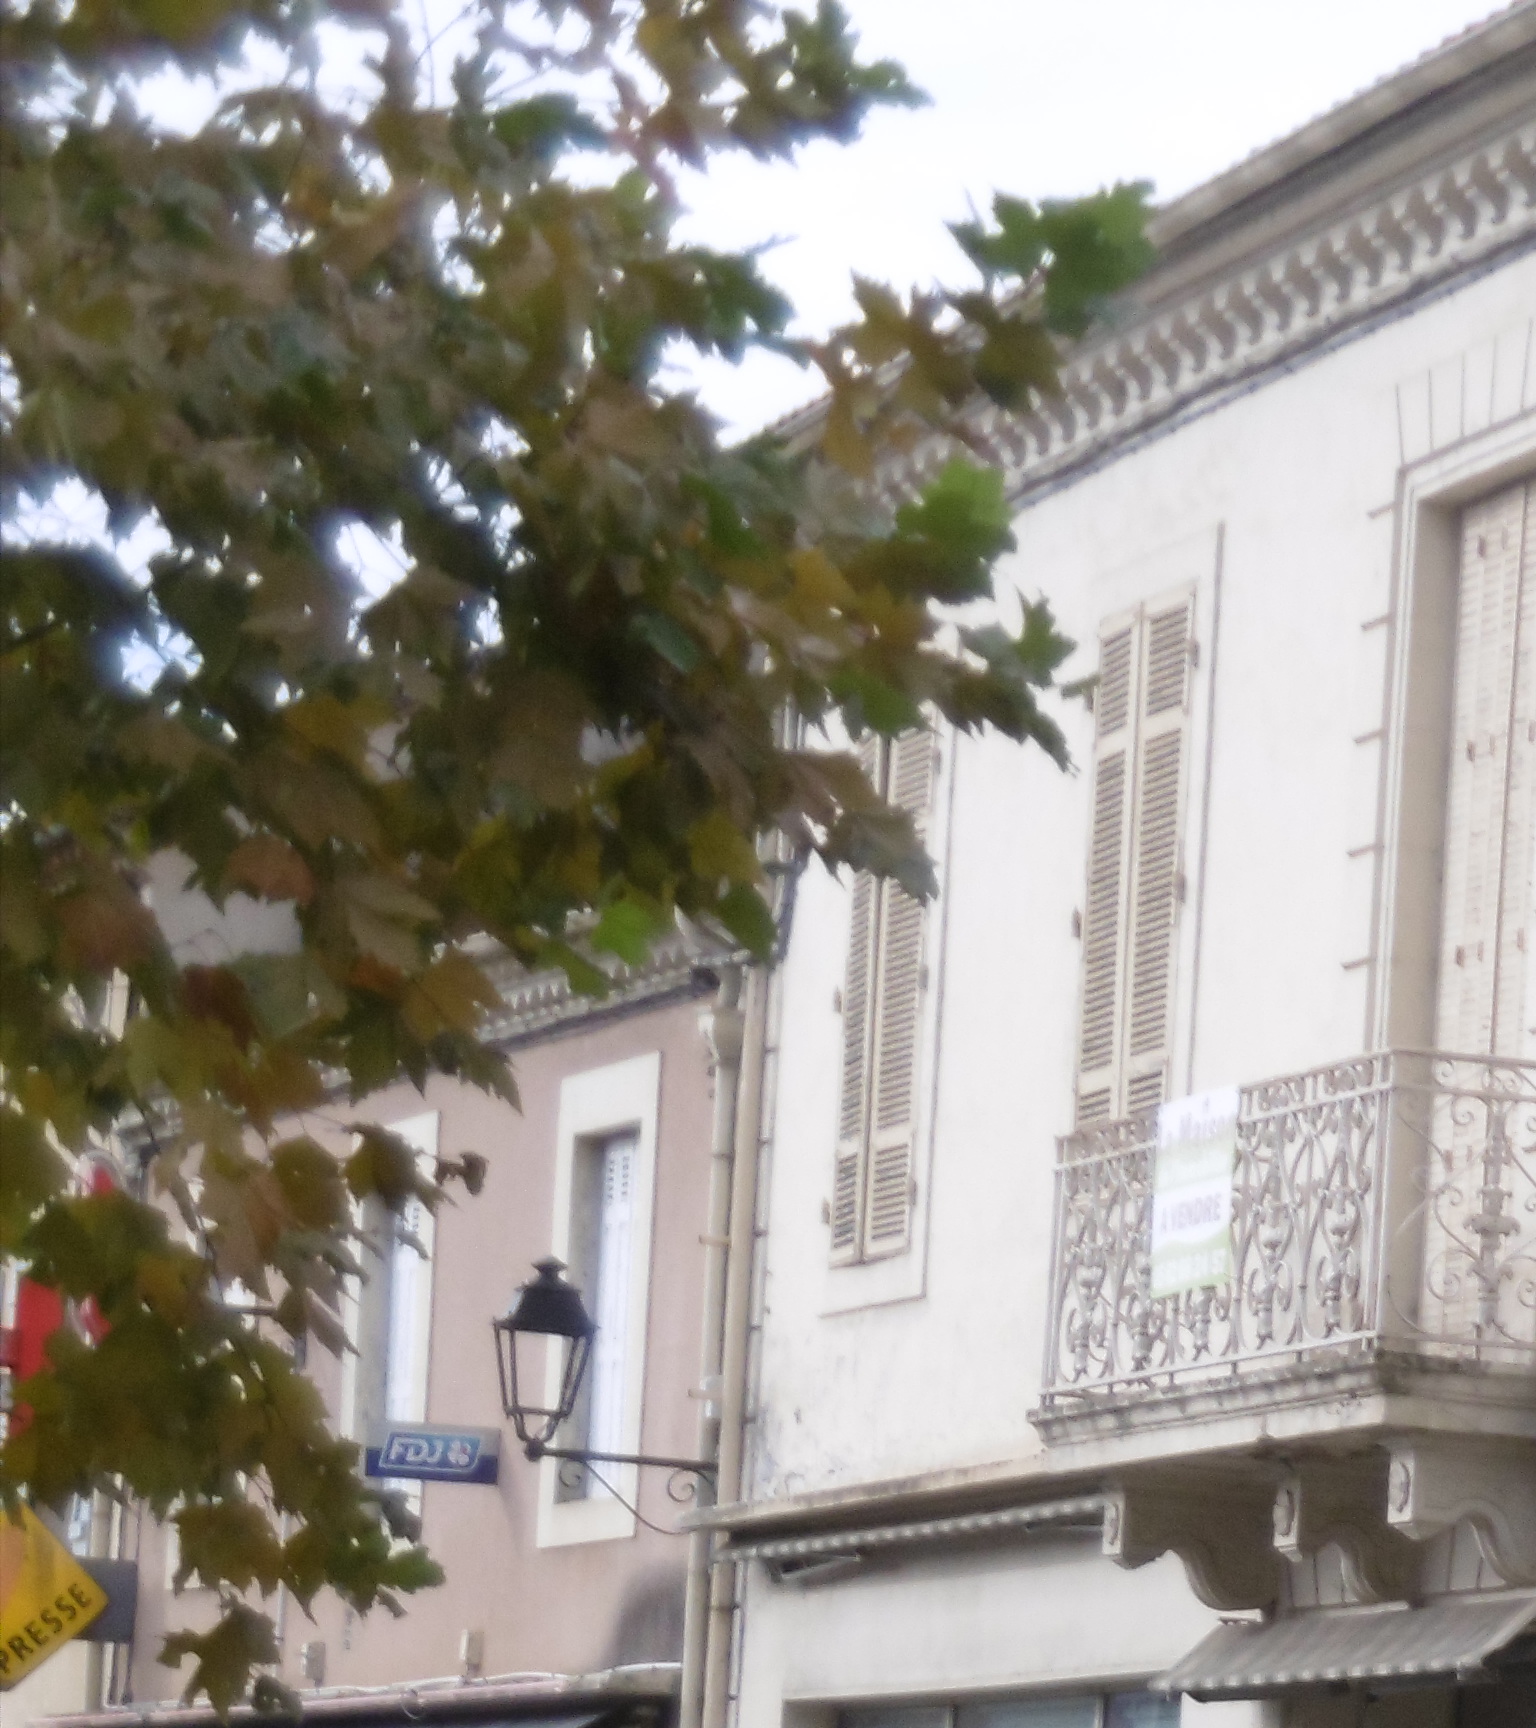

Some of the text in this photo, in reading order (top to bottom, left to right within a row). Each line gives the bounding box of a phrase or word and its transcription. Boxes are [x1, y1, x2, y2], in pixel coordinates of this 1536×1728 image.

[1171, 1192, 1222, 1231] VENDRE
[388, 1437, 443, 1463] FDJ
[0, 1583, 92, 1674] PRESSE
